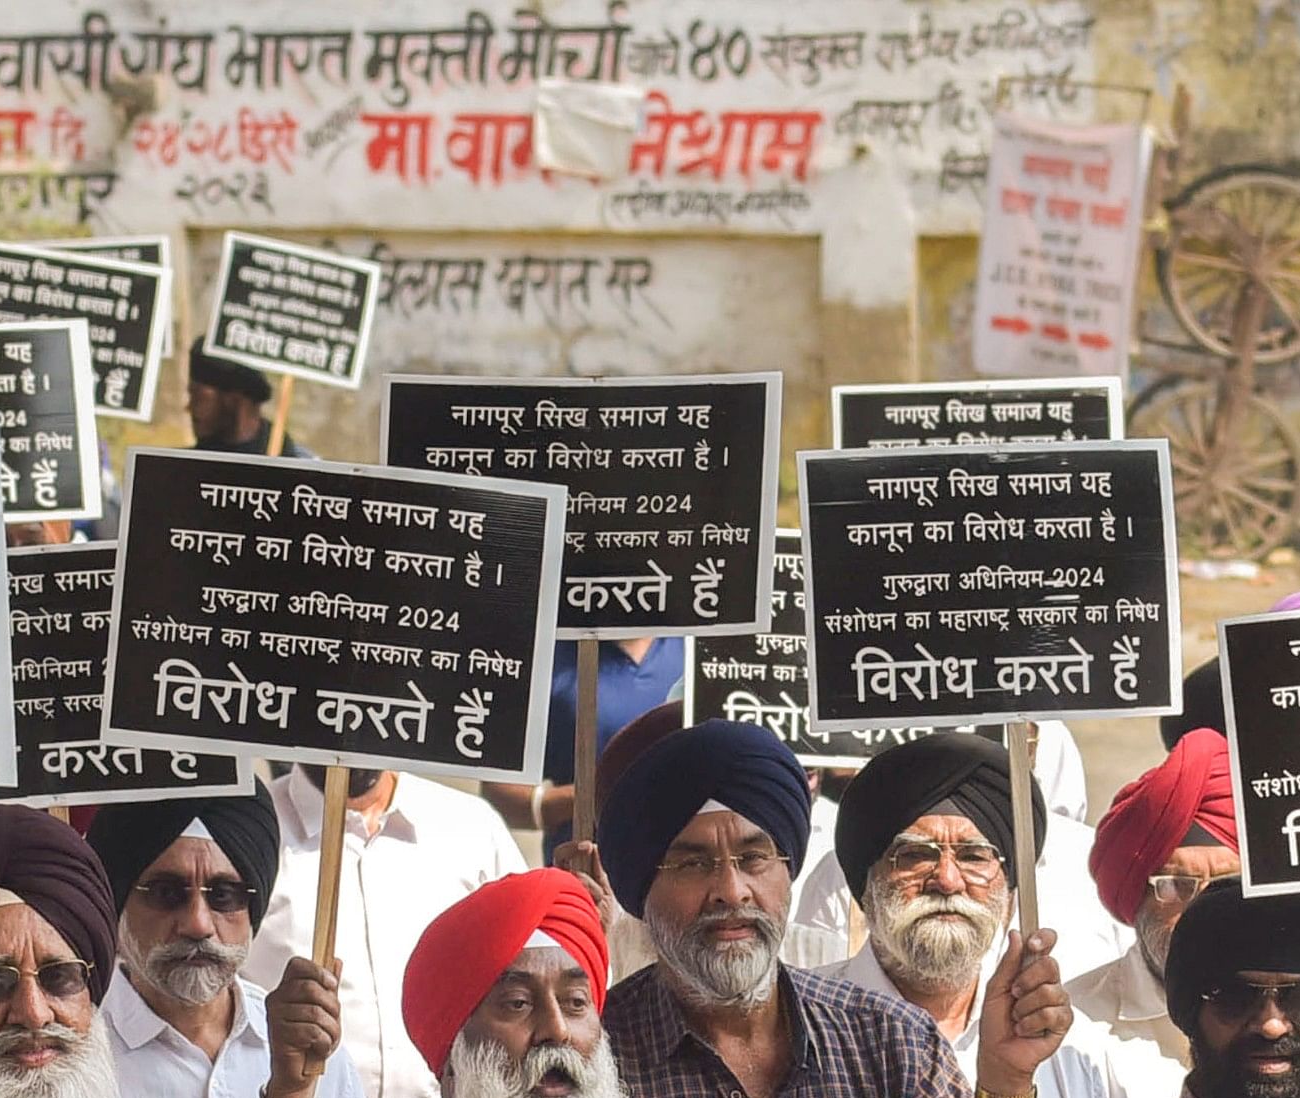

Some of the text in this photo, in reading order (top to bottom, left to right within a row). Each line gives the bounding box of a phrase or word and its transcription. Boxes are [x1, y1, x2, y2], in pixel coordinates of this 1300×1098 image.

[225, 24, 352, 106] भारत
[4, 342, 32, 363] यह
[451, 400, 712, 435] नागपूर सिख समाज यह
[885, 399, 1073, 430] नागपूर सिख समाज यह
[200, 483, 486, 540] नागपूर सिख समाज यह
[867, 468, 1112, 507] नागपूर सिख समाज यह
[170, 528, 246, 565] कानून
[256, 536, 292, 561] का
[302, 533, 375, 570] विरोध
[385, 550, 455, 579] करता
[464, 550, 483, 587] है
[201, 587, 459, 632] गुरुद्वारा अधिनियम 2024
[565, 557, 725, 618] करते हैं
[131, 614, 523, 679] संशोधन का महाराष्ट्र सरकार का निषेध
[851, 635, 1140, 702] विरोध करते हैं
[153, 658, 493, 758] विरोध करते हैं
